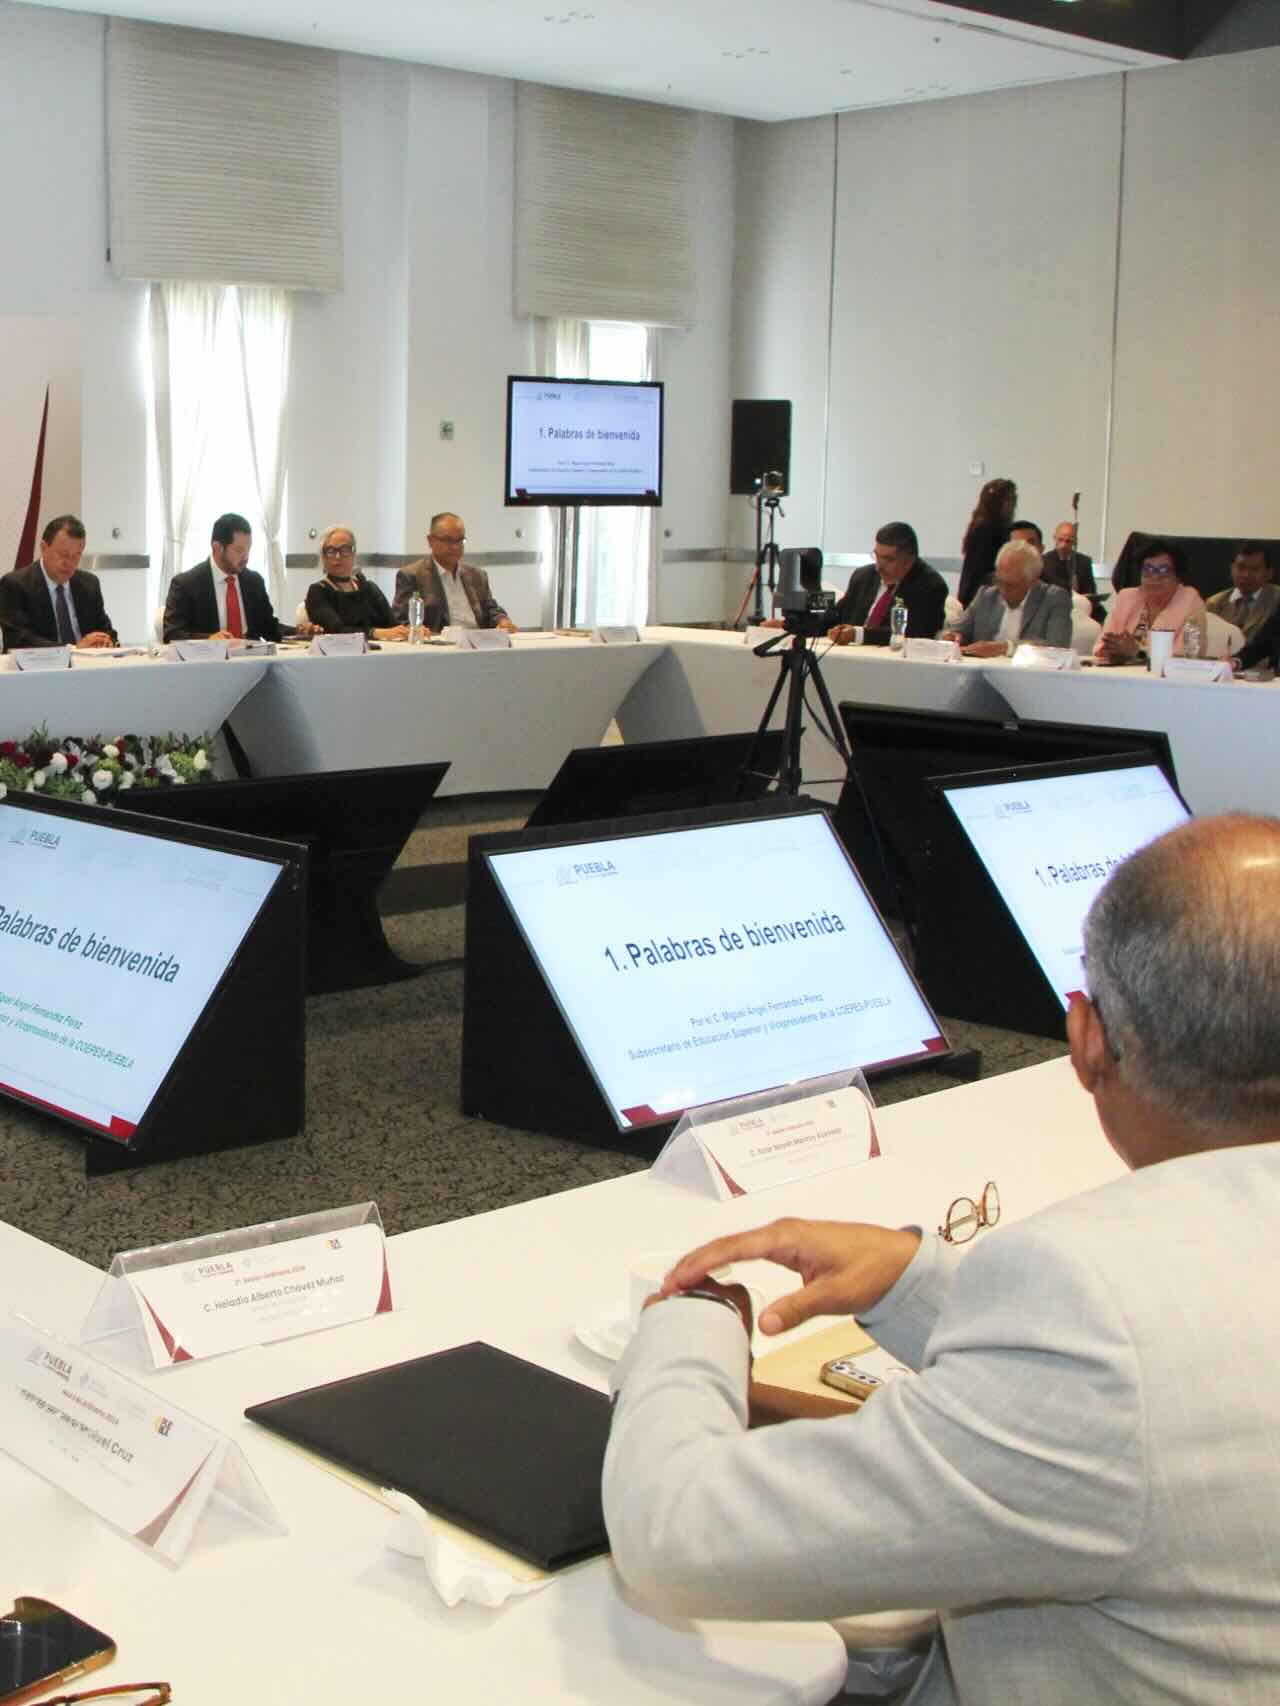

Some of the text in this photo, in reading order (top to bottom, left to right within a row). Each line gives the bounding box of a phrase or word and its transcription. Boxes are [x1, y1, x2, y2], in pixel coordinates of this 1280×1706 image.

[548, 426, 584, 441] Palabras
[597, 428, 641, 441] bienvenida
[573, 860, 616, 875] PUEBLA
[1034, 865, 1053, 888] 1.
[1047, 862, 1106, 885] Palabras
[604, 909, 847, 973] 1. Palabras de bienvenida
[57, 927, 82, 953] de
[80, 932, 181, 984] bienvenida
[250, 1287, 283, 1303] Alberto
